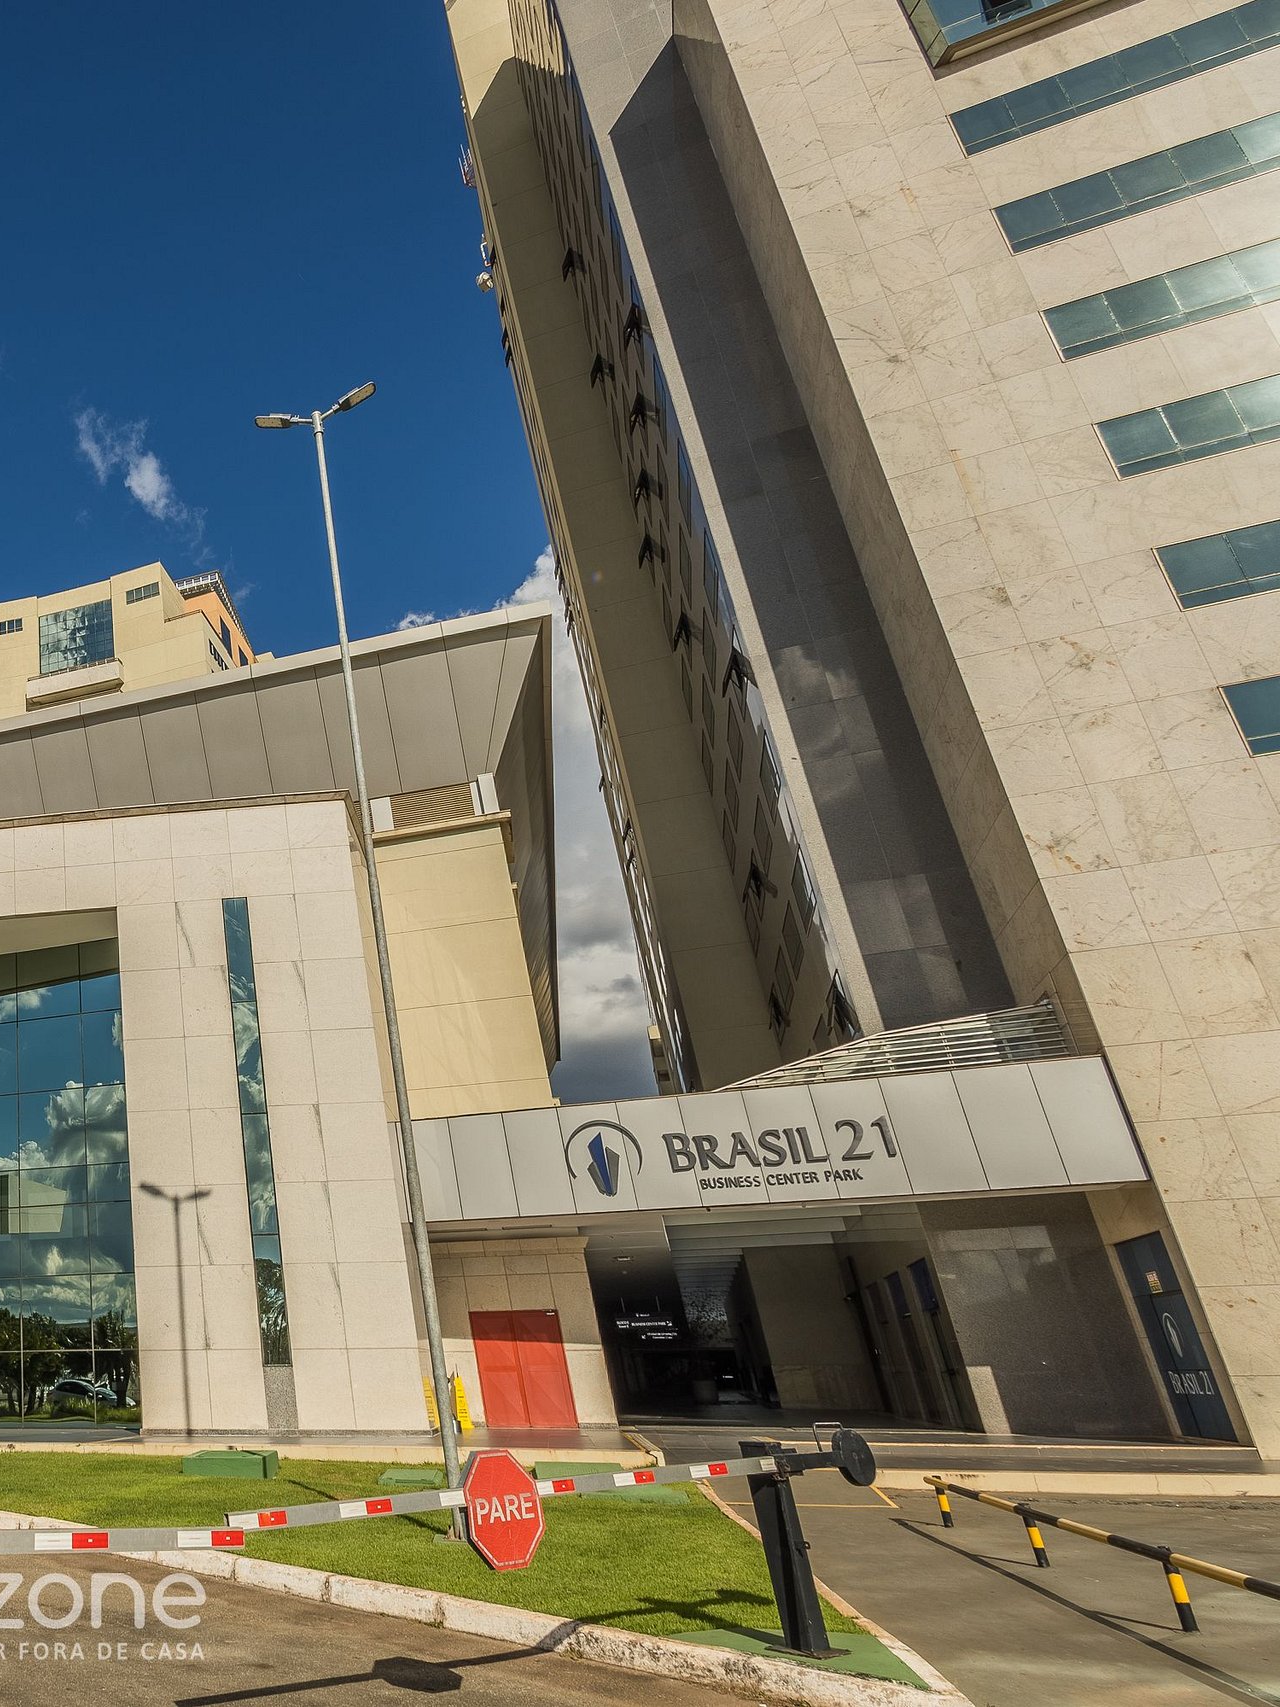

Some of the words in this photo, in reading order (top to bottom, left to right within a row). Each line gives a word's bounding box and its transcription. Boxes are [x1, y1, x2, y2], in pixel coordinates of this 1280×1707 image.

[661, 1127, 831, 1172] BRASIL
[834, 1114, 897, 1162] 21
[699, 1175, 762, 1191] BUSINESS
[766, 1171, 821, 1187] CENTER
[824, 1167, 864, 1183] PARK
[1168, 1371, 1203, 1395] BRASIL
[1199, 1371, 1215, 1395] 21
[475, 1492, 535, 1526] PARE
